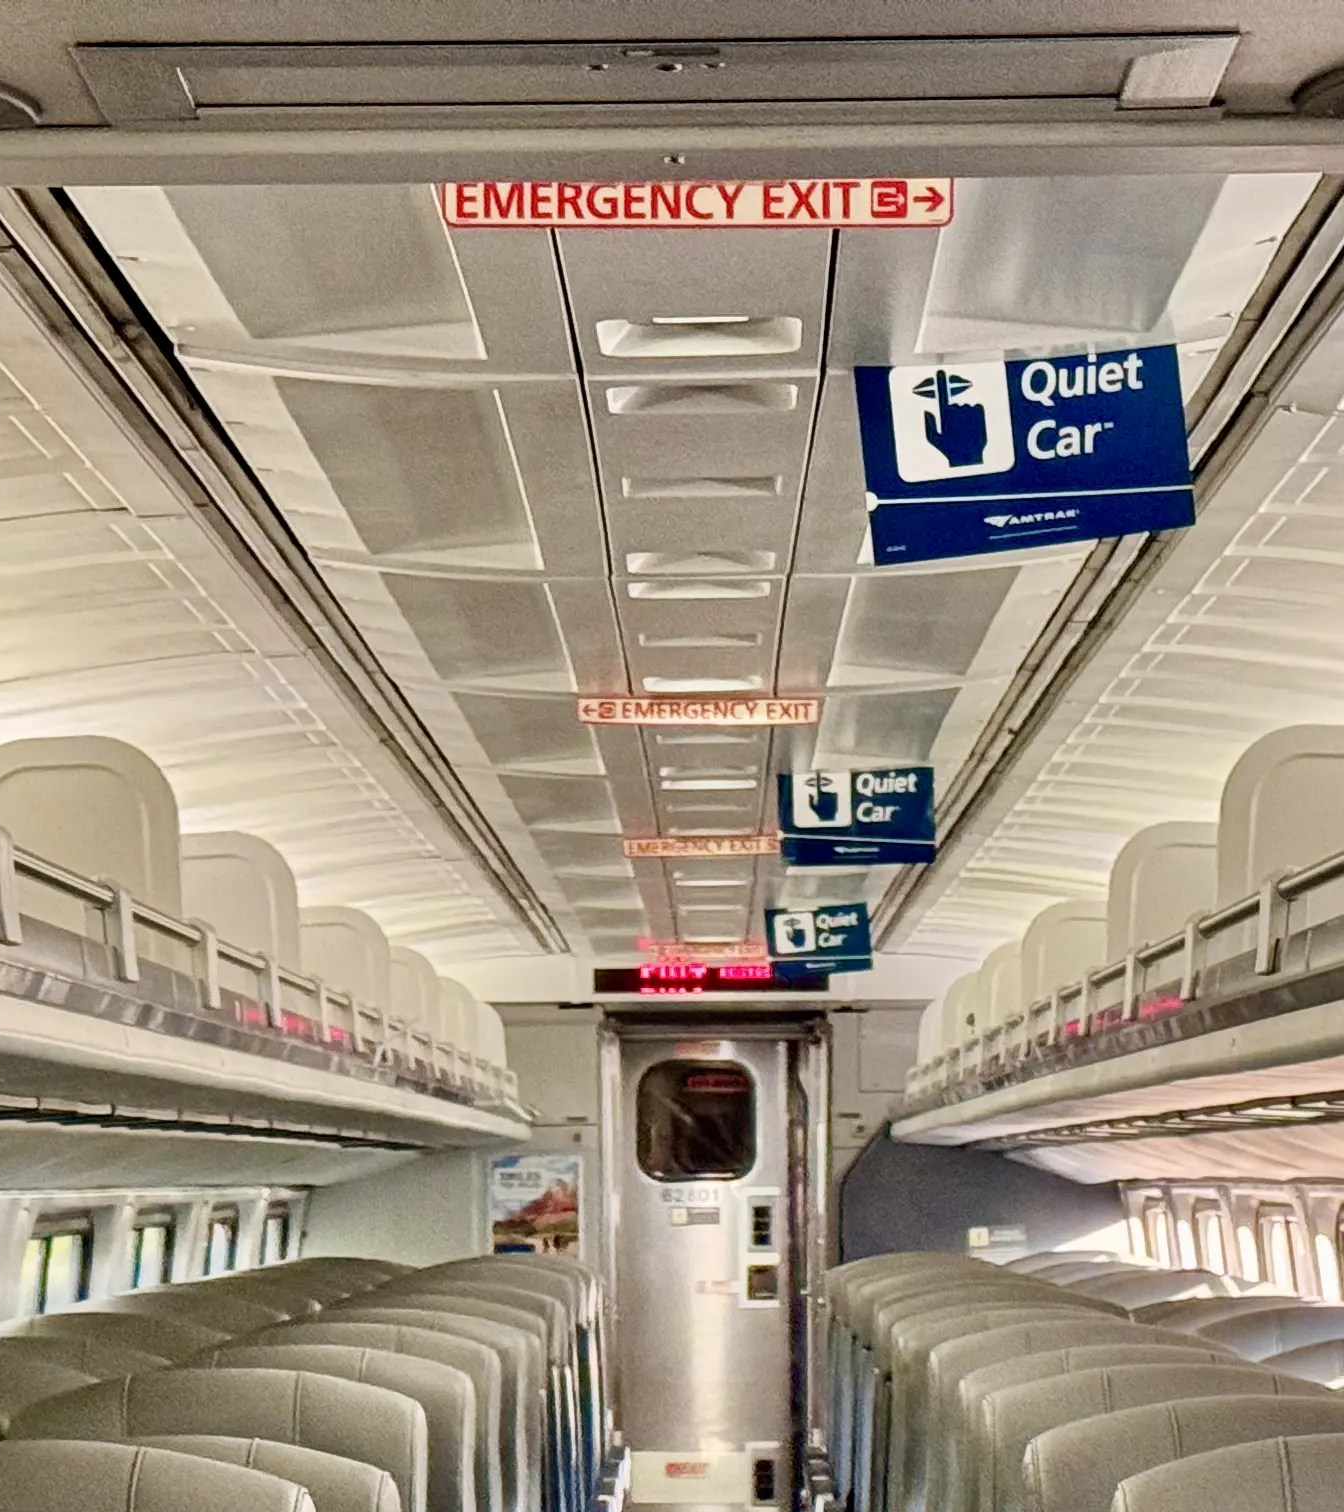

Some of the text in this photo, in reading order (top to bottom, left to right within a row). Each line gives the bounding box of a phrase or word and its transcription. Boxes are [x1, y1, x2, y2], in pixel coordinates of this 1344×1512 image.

[455, 180, 862, 220] EMERGENCY EXIT
[1021, 352, 1144, 407] Quiet
[622, 700, 813, 721] EMERGENCY EXIT
[856, 771, 918, 797] Quiet
[856, 802, 894, 823] Car
[816, 911, 859, 930] Quiet
